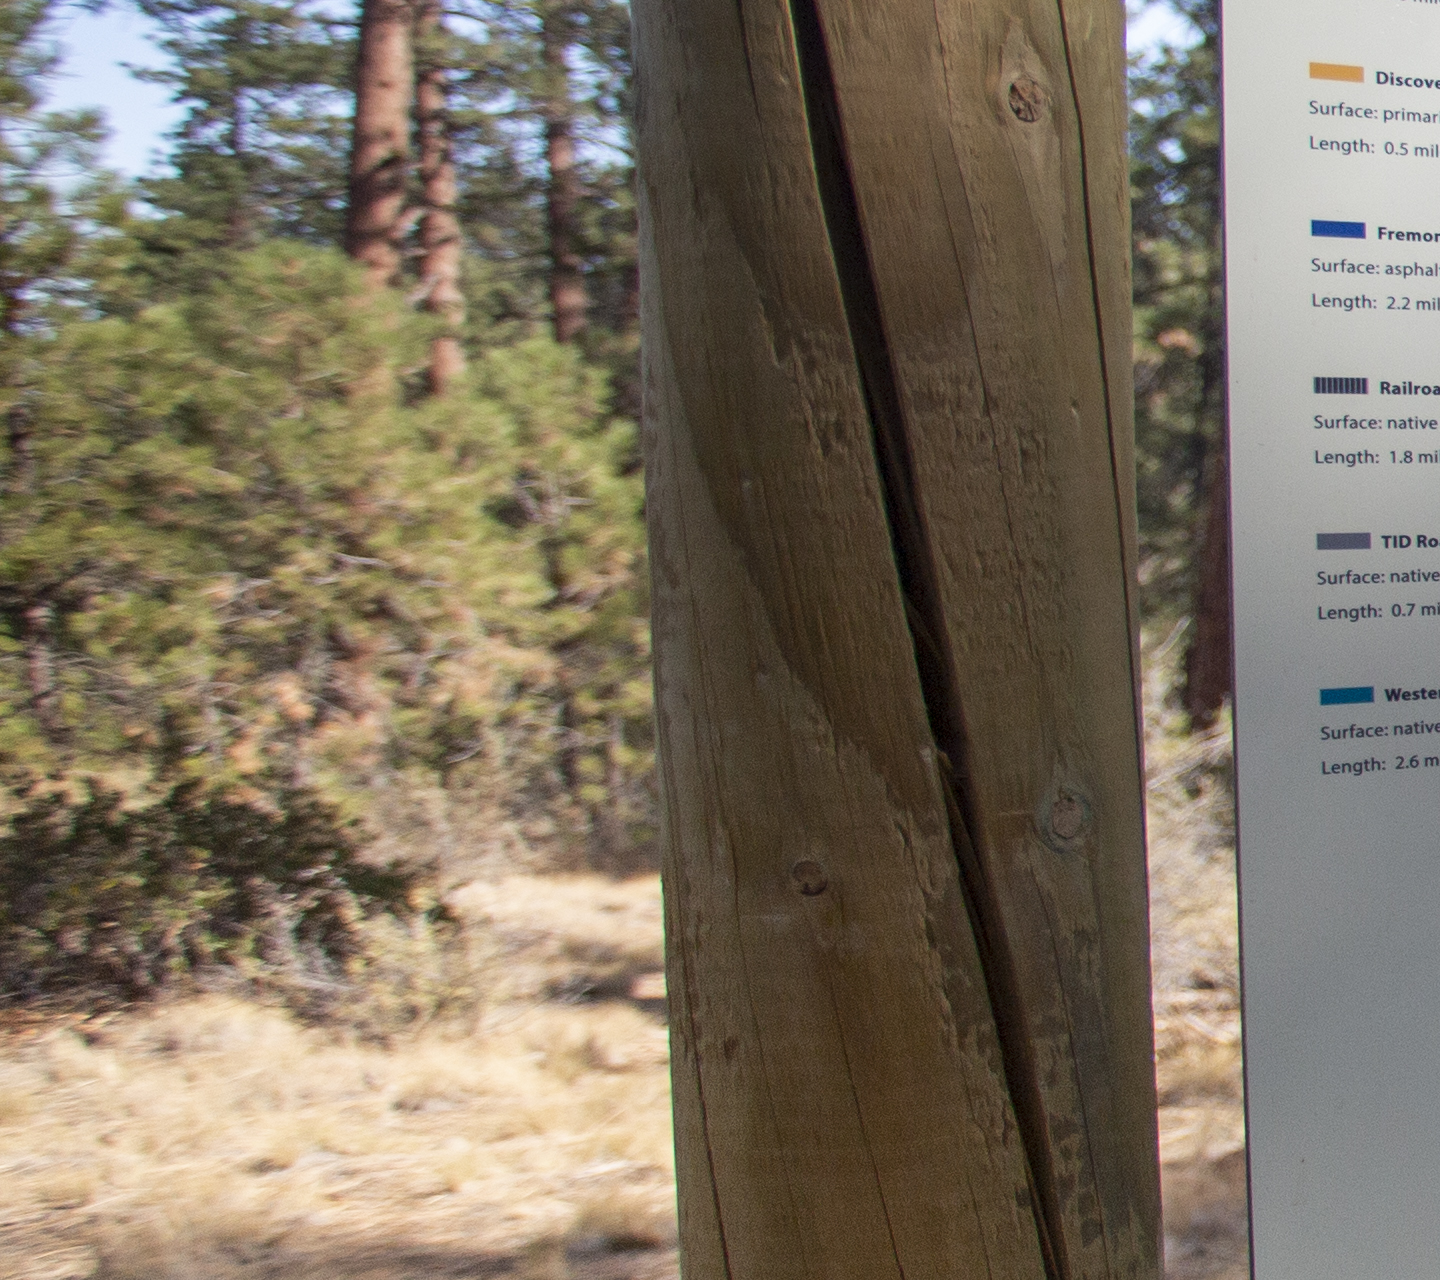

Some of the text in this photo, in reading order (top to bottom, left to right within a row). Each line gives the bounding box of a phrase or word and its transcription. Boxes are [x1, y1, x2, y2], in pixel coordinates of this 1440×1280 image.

[1310, 101, 1379, 118] Surface:
[1310, 136, 1375, 155] Length:
[1384, 142, 1408, 155] 0.5
[1312, 258, 1380, 274] Surface:
[1312, 294, 1377, 311] Length:
[1387, 297, 1410, 310] 2.2
[1314, 415, 1381, 429] Surface:
[1388, 418, 1437, 429] native
[1315, 450, 1378, 467] Length:
[1391, 451, 1413, 463] 1.8
[1382, 535, 1411, 548] TID
[1317, 570, 1384, 585] Surface:
[1390, 570, 1440, 582] native
[1318, 604, 1381, 622] Length:
[1392, 603, 1415, 617] 0.7
[1321, 724, 1388, 740] Surface:
[1322, 758, 1385, 776] Length:
[1396, 755, 1419, 769] 2.6
